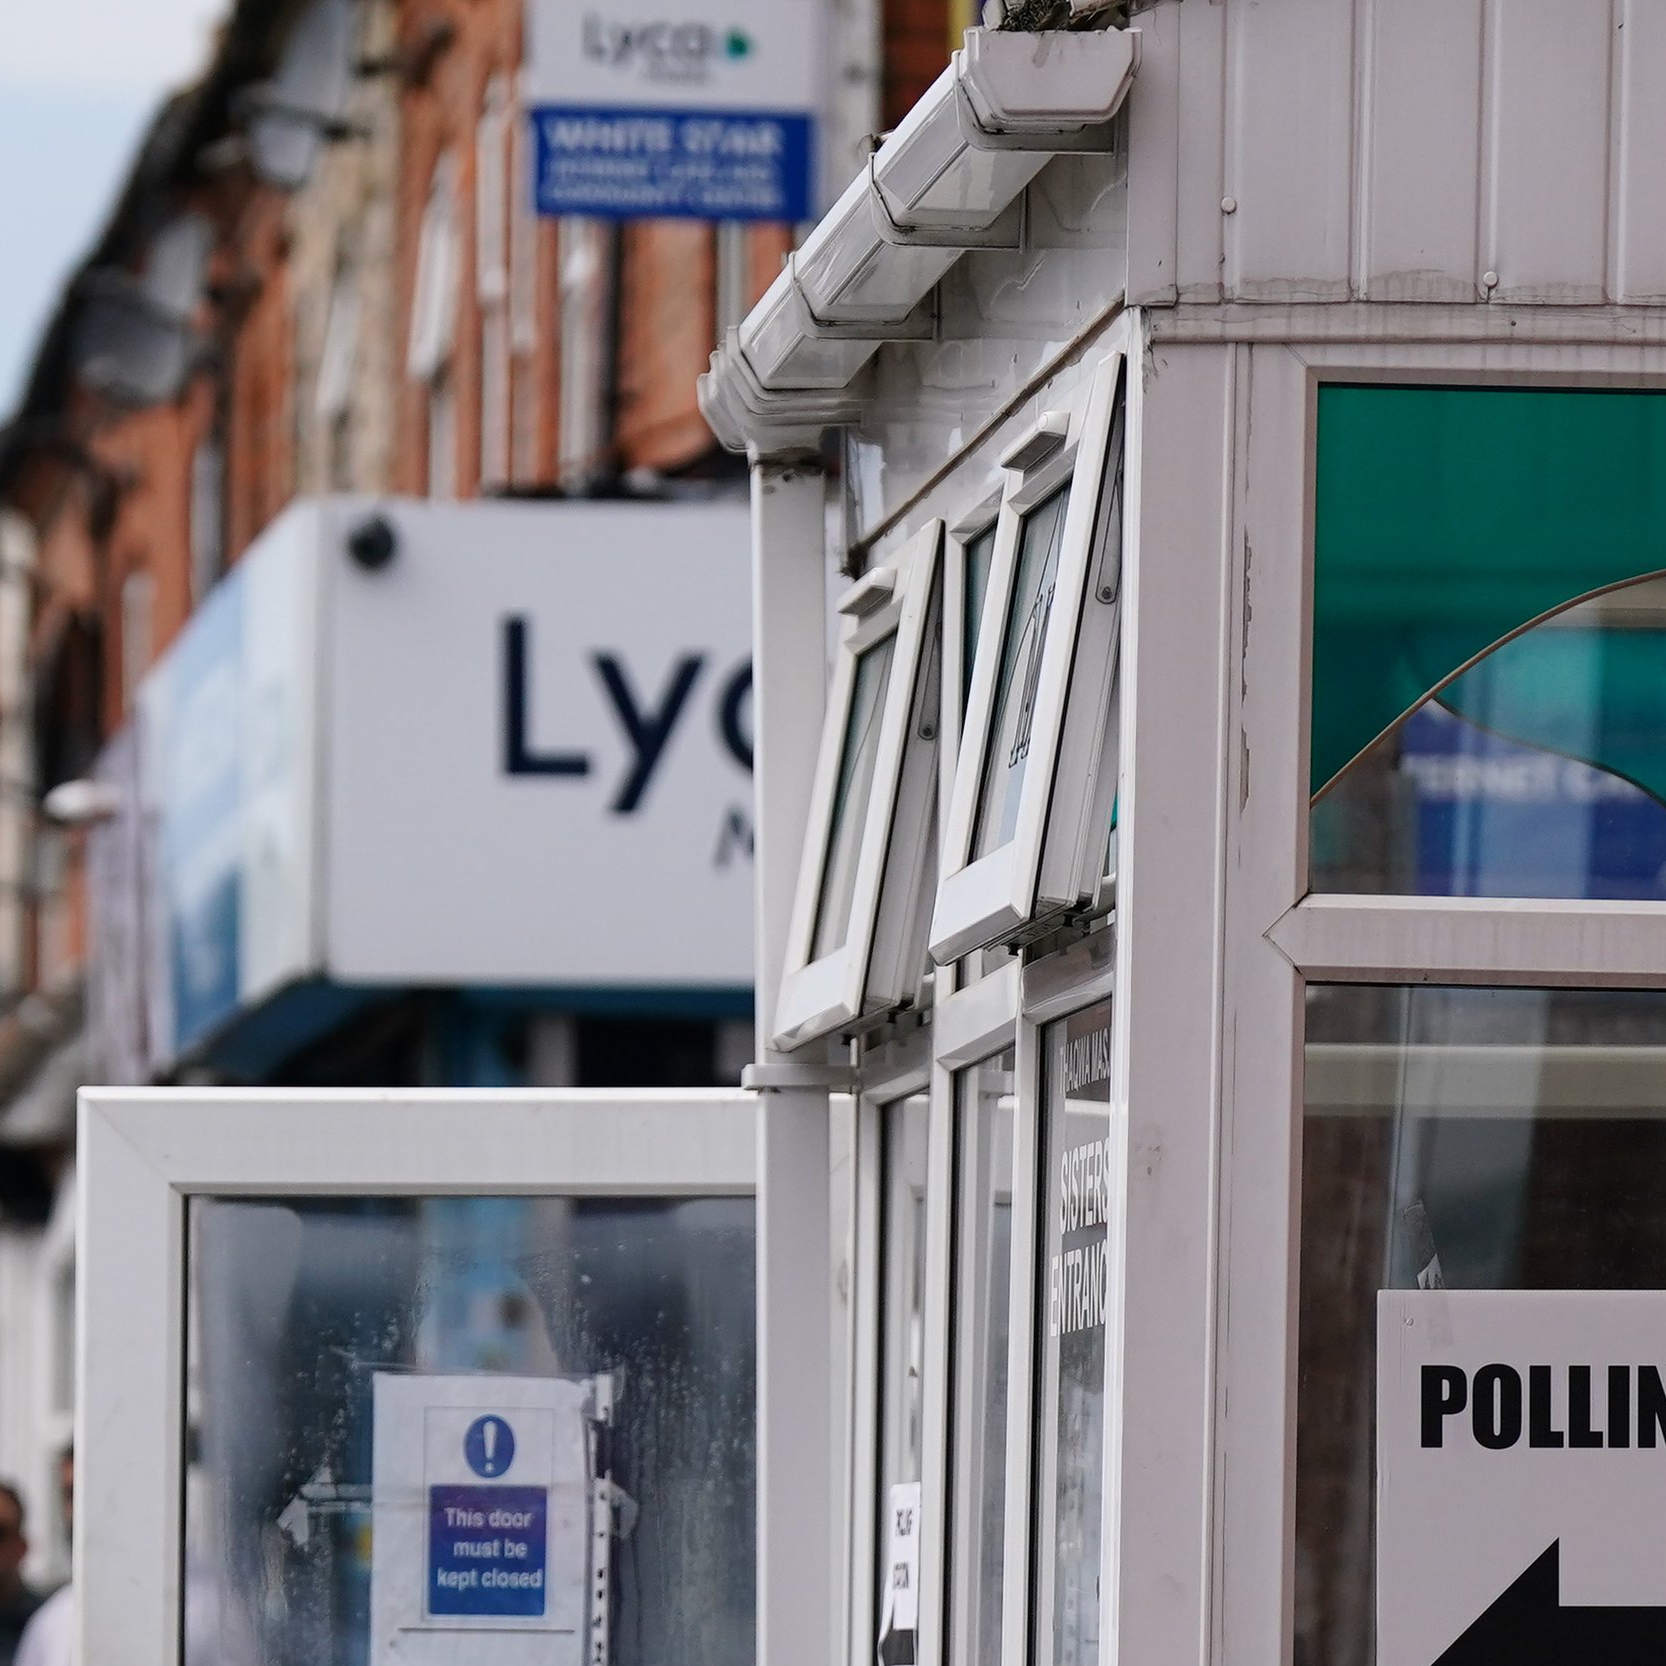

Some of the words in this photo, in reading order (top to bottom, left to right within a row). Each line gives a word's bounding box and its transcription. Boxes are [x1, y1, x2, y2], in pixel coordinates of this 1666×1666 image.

[1091, 1027, 1111, 1082] MAS
[444, 1507, 484, 1528] This
[488, 1508, 533, 1529] door
[453, 1539, 500, 1558] must
[503, 1538, 528, 1559] be
[437, 1567, 478, 1592] kept
[481, 1567, 544, 1589] closed
